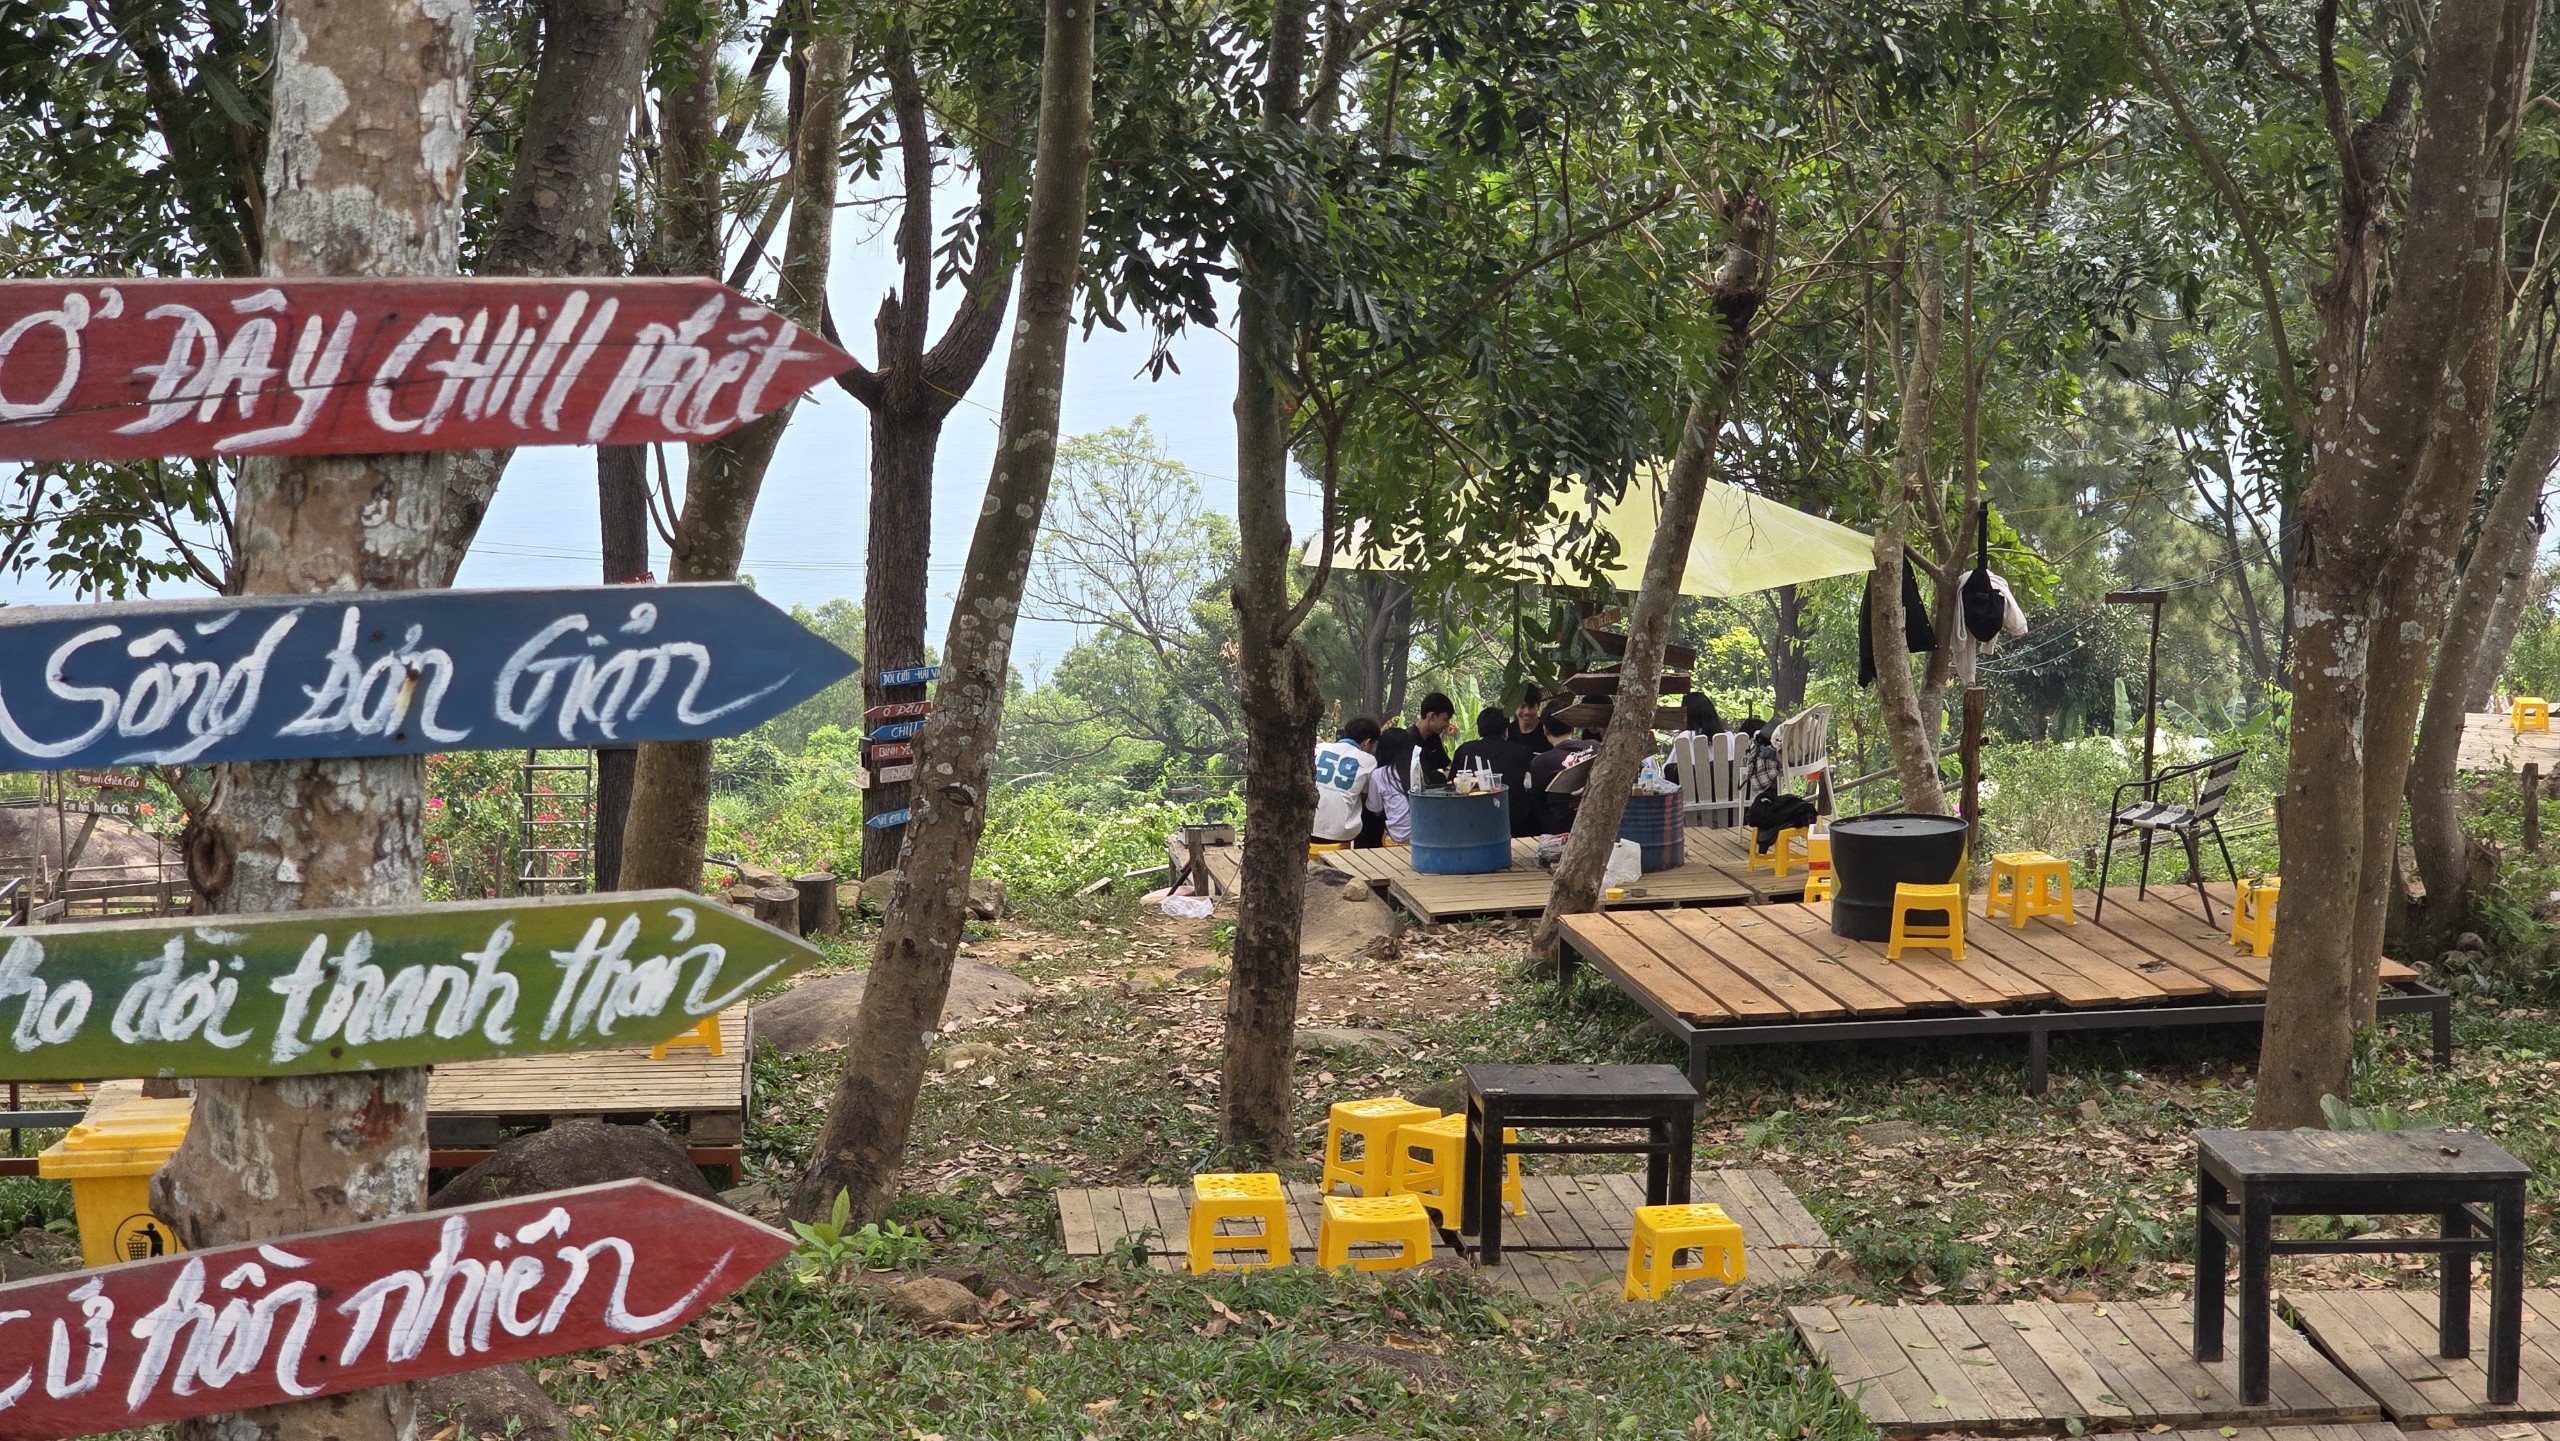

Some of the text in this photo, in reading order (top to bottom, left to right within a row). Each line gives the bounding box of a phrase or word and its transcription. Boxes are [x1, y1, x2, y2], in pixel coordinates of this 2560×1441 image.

[1316, 750, 1359, 791] 59
[0, 936, 93, 1052] ho
[270, 920, 519, 1064] thanh
[338, 1207, 734, 1366] nhiên
